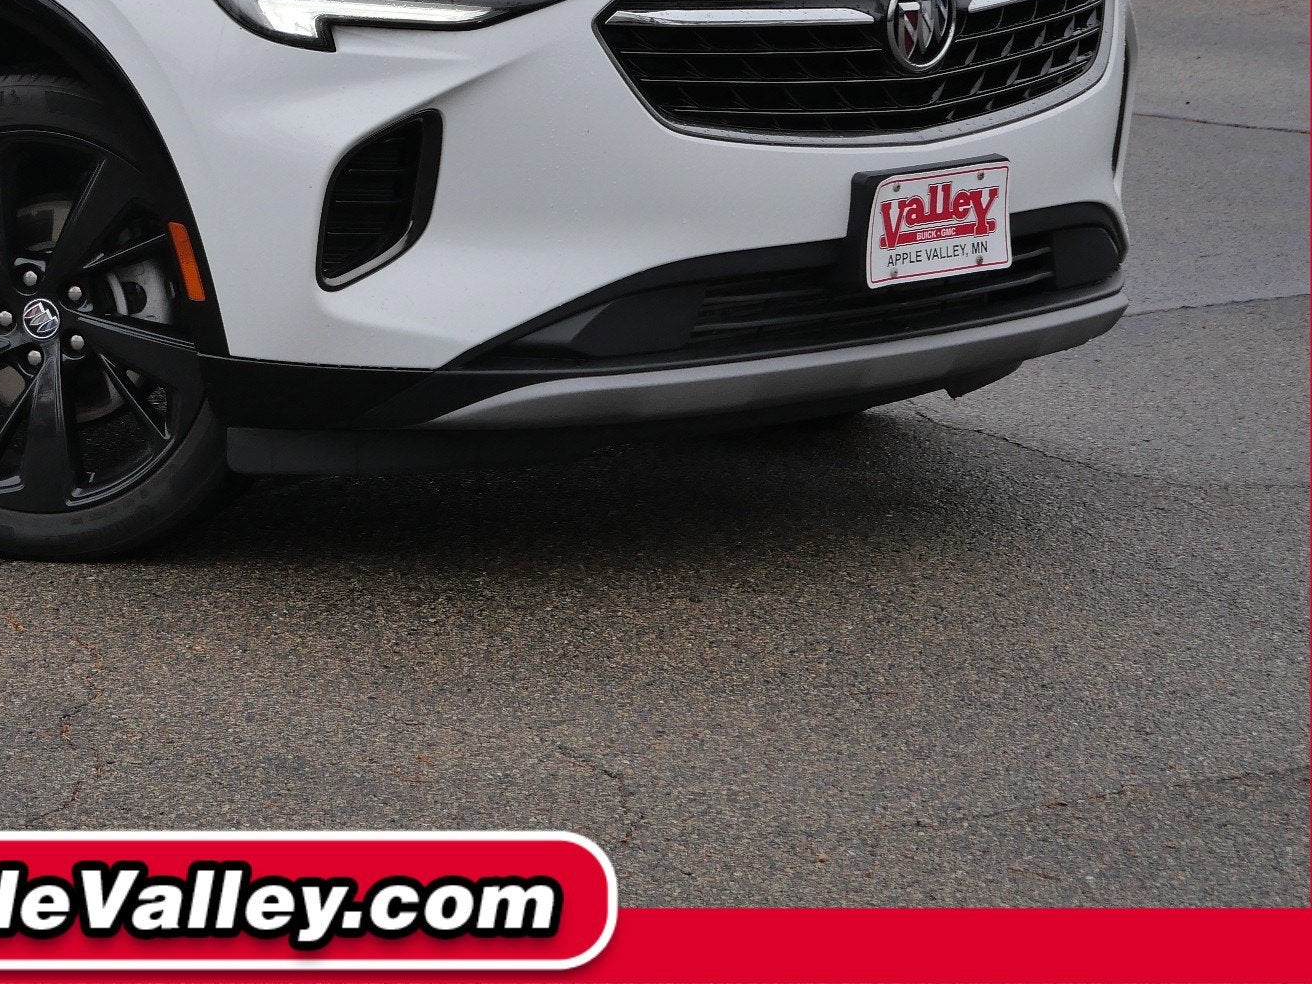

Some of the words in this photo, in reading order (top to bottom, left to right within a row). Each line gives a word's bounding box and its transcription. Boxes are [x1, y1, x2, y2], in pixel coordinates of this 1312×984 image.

[916, 229, 937, 241] BUICK
[941, 227, 956, 237] GMC
[887, 250, 922, 267] APPLE
[925, 243, 969, 261] VALLEY,
[971, 240, 988, 255] MN
